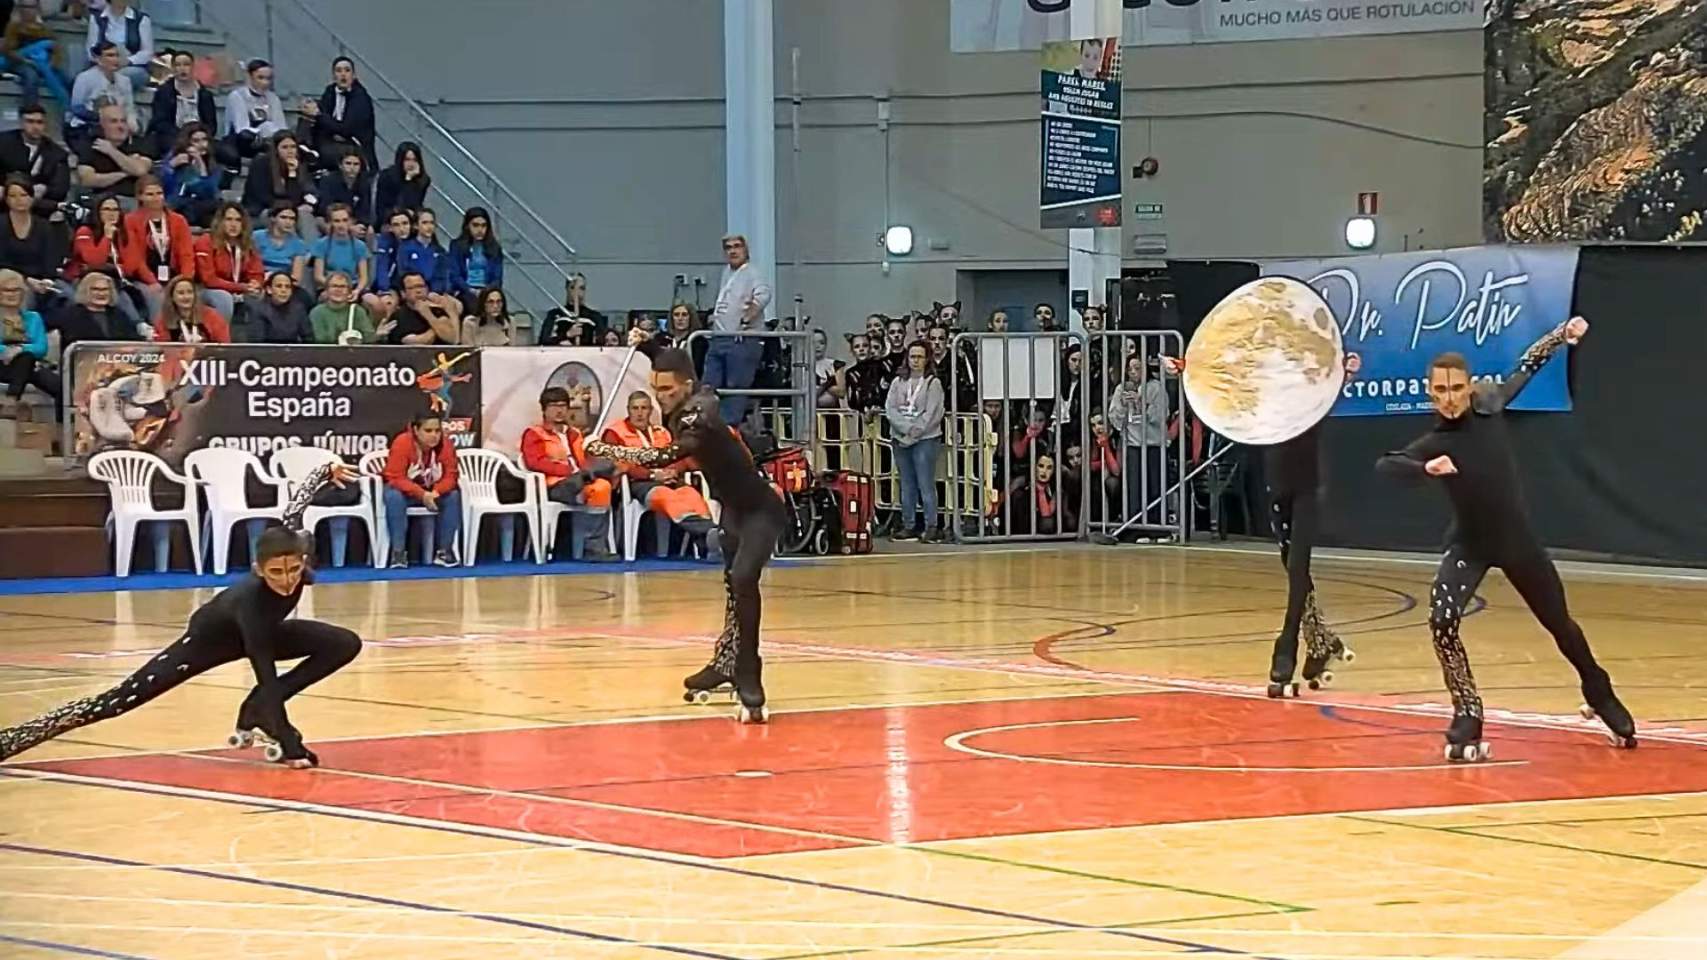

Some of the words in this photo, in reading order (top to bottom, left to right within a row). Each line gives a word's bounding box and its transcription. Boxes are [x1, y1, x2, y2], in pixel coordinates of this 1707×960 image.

[1219, 11, 1282, 27] MUCHO
[1327, 6, 1362, 21] QUE
[97, 353, 138, 363] ALCOY
[139, 353, 165, 363] 2024
[179, 360, 416, 392] XIII-Campeonato
[248, 391, 351, 423] España
